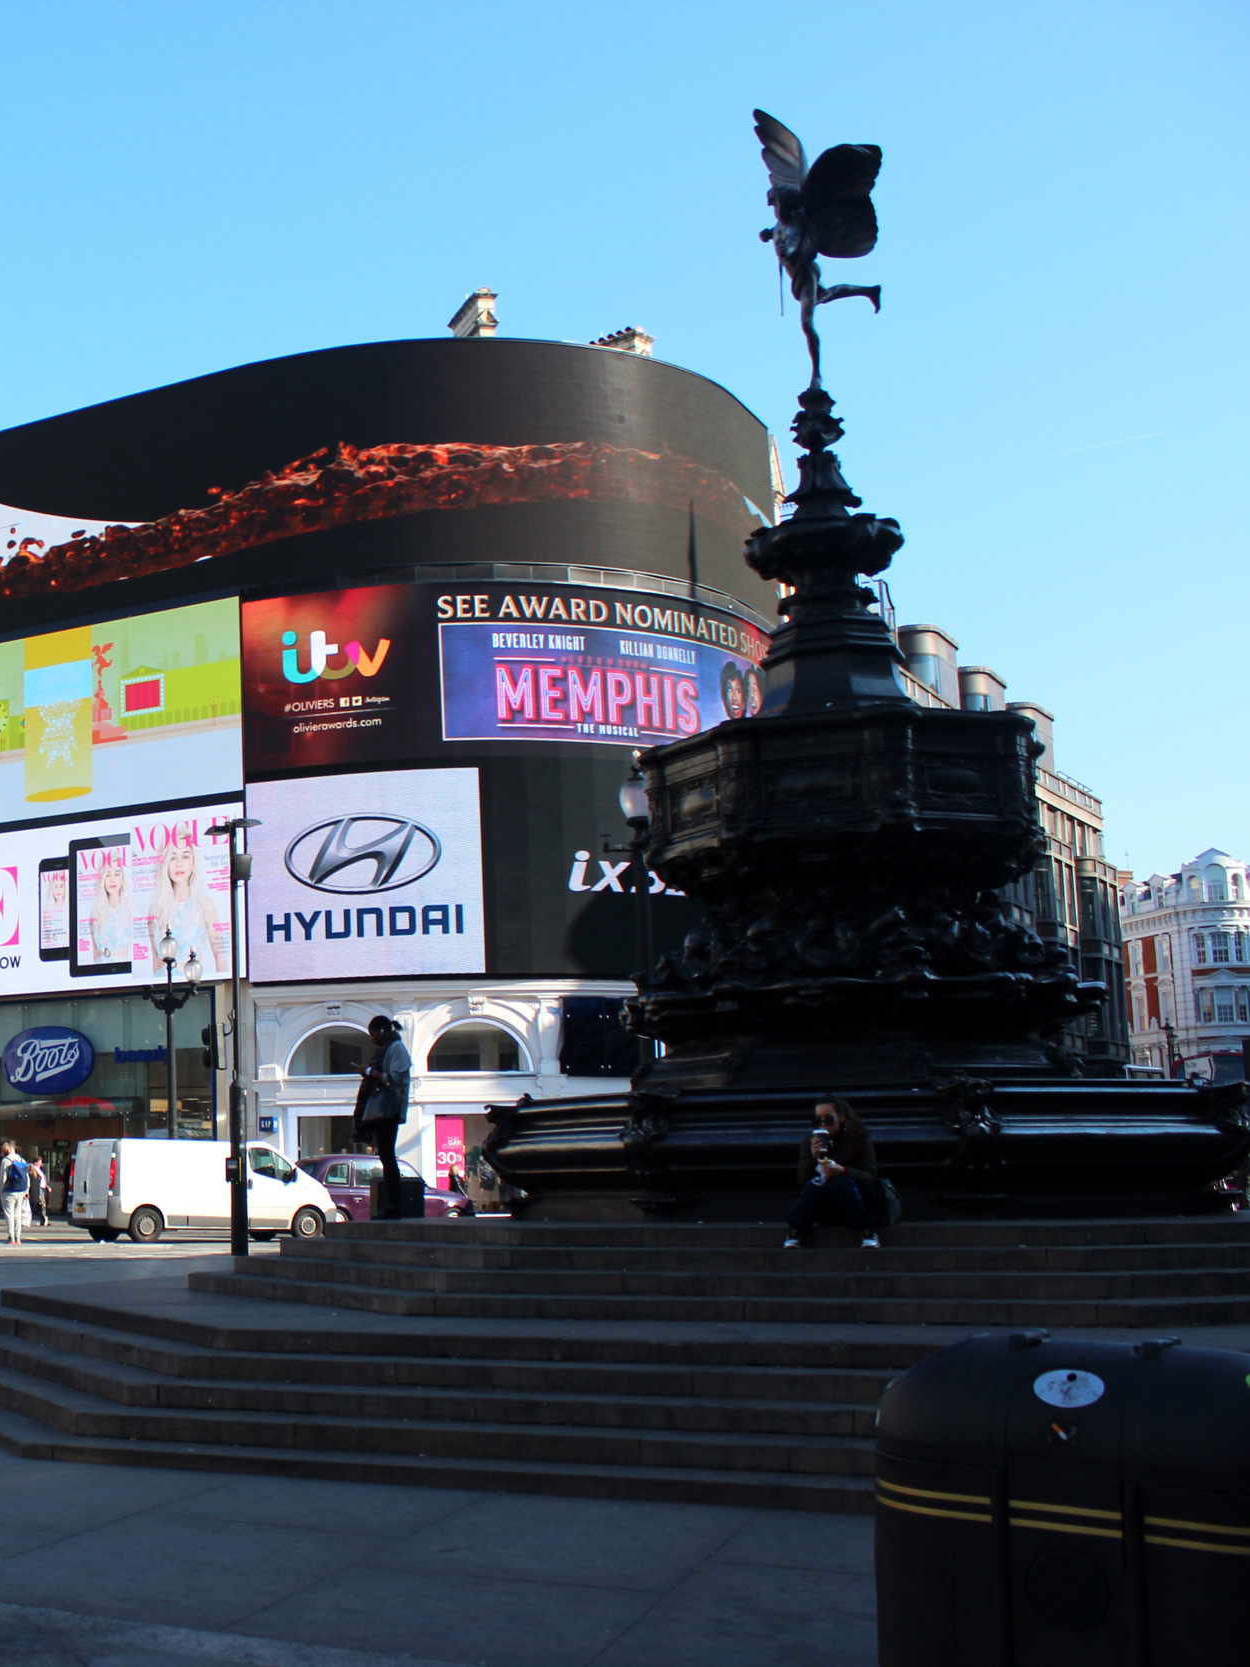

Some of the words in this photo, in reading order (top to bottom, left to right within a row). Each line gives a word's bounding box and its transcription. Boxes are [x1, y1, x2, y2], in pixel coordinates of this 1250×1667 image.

[437, 594, 490, 619] SEE
[498, 595, 609, 623] AWARD
[615, 602, 738, 648] NOMINATED
[281, 630, 391, 684] itv
[492, 633, 545, 649] BEVERLEY
[548, 635, 586, 651] KNIGHT
[619, 640, 654, 656] KILLIAN
[656, 644, 696, 665] DONNELLY
[284, 699, 335, 712] #OLIVIERS
[495, 663, 699, 734] MEMPHIS
[293, 718, 382, 734] olivierawards.com
[577, 723, 596, 733] THE
[600, 725, 639, 737] MUSICAL
[134, 816, 230, 853] VOGUE
[266, 904, 464, 943] HYUNDAI
[10, 1037, 80, 1083] Boots
